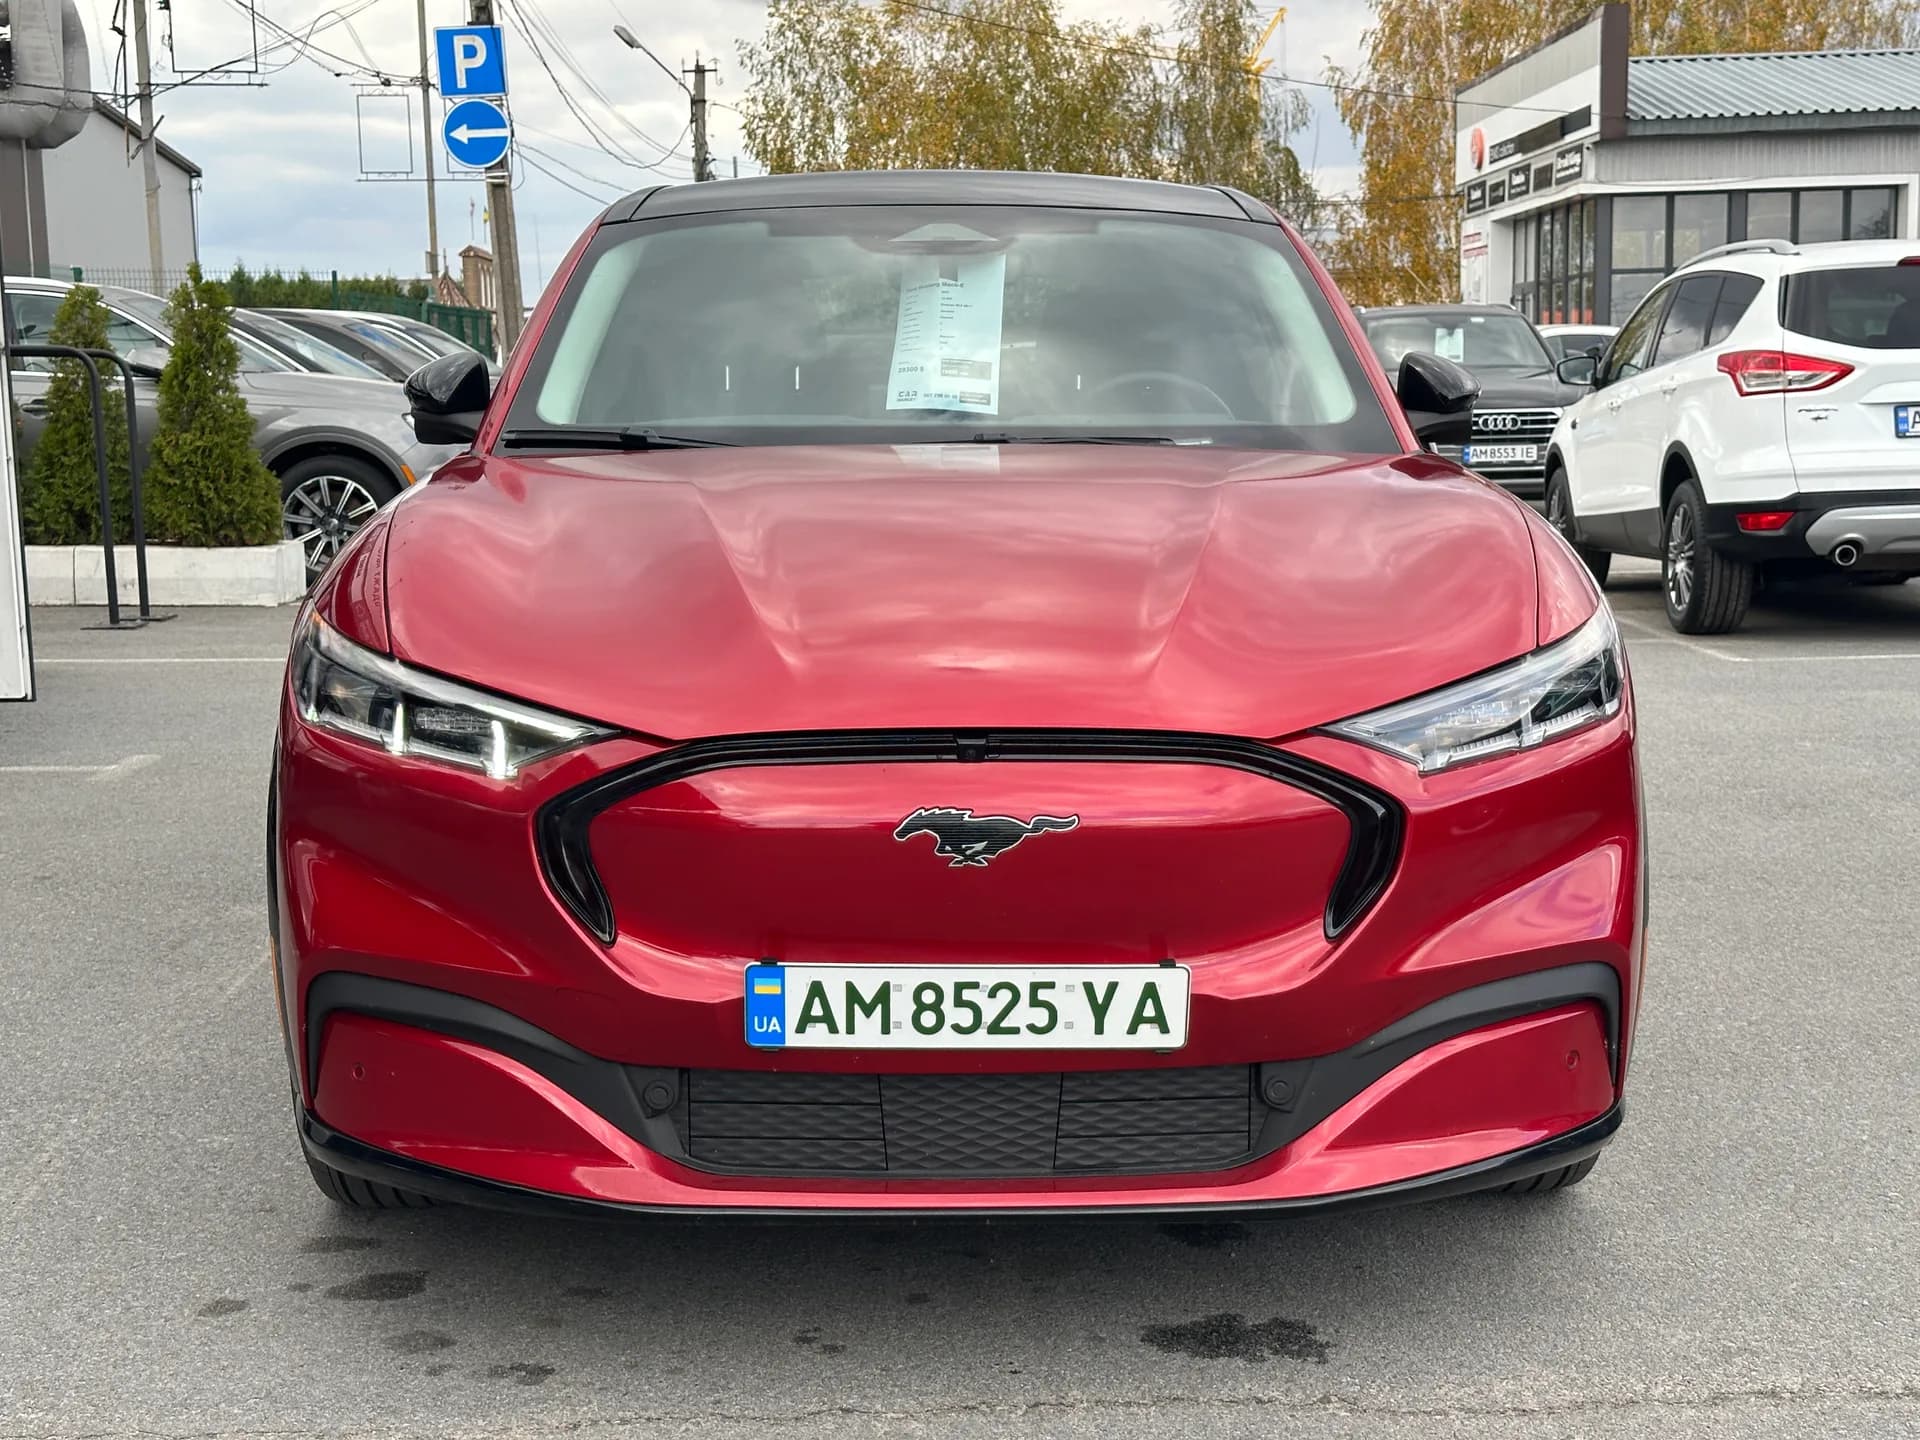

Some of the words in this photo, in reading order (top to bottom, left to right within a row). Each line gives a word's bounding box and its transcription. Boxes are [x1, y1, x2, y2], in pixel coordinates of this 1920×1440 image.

[453, 35, 487, 89] P
[1471, 447, 1488, 459] AM
[1489, 447, 1516, 459] 8553
[1521, 447, 1535, 458] IE
[754, 1016, 782, 1032] UA
[795, 981, 891, 1035] AM
[911, 981, 1058, 1035] 8525
[1082, 981, 1171, 1035] YA
